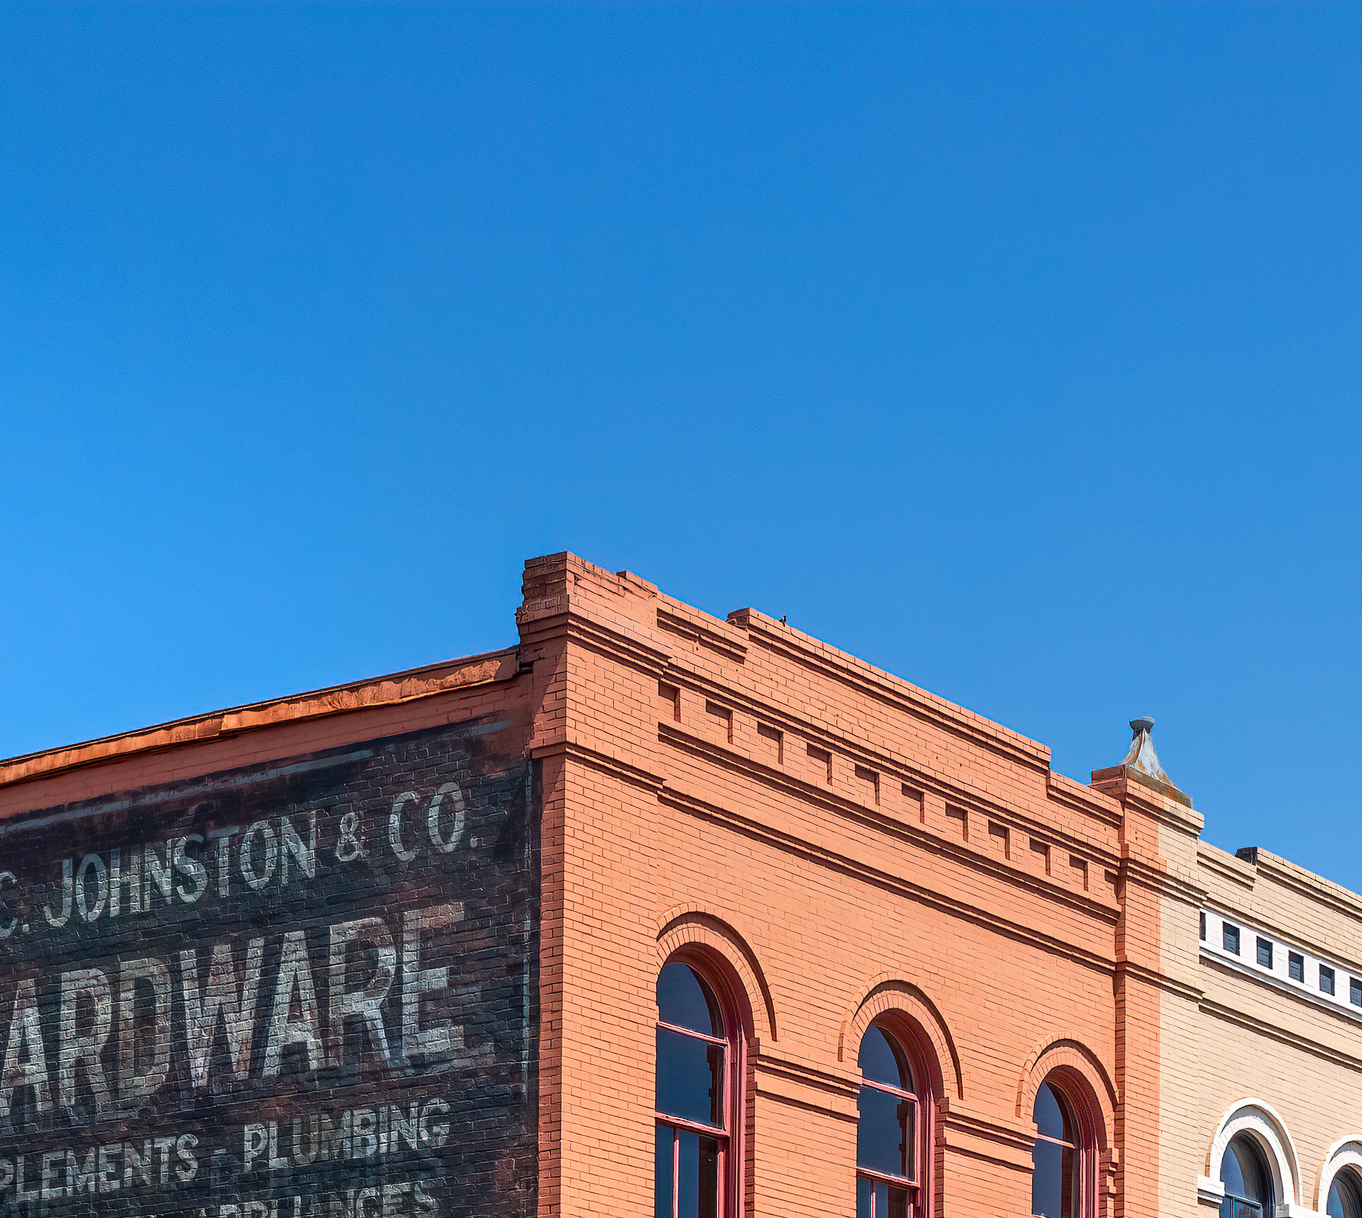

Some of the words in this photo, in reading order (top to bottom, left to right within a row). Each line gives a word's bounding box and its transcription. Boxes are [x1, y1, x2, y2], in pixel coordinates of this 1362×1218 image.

[42, 809, 318, 929] JOHNSTON
[335, 811, 370, 863] &
[242, 1097, 451, 1172] PLUMBING
